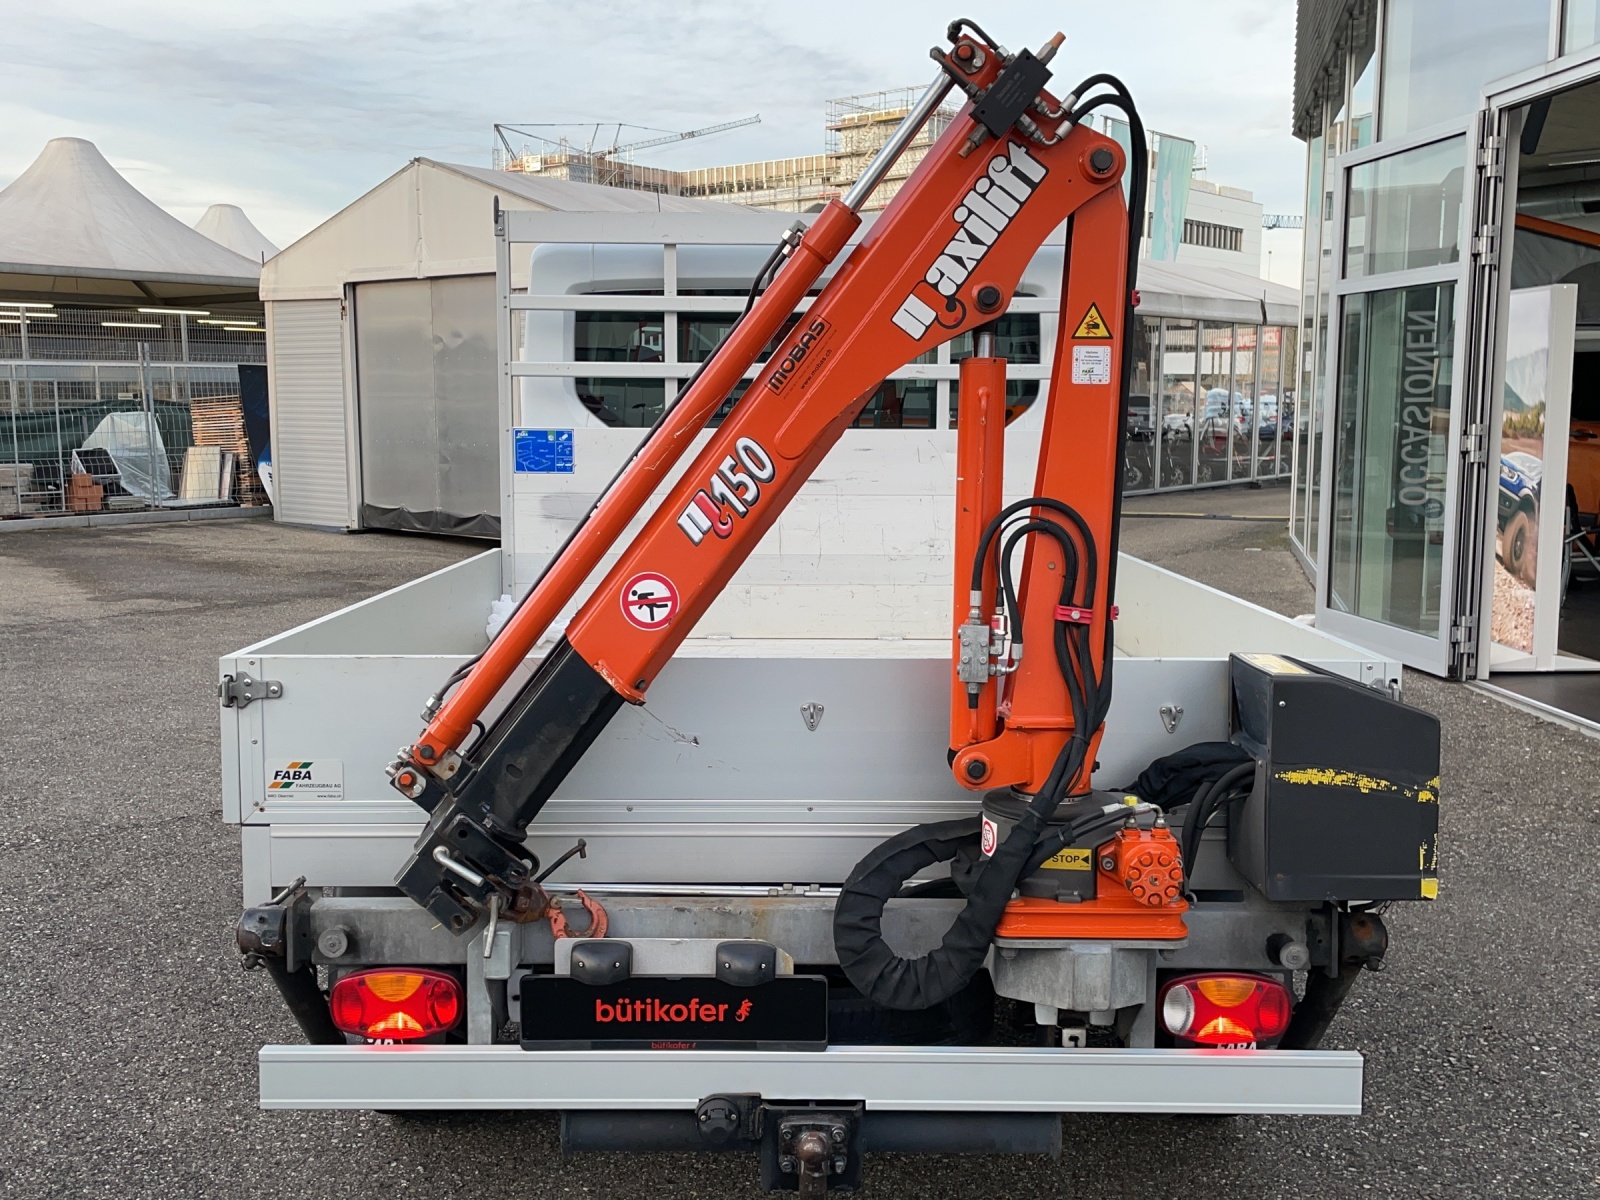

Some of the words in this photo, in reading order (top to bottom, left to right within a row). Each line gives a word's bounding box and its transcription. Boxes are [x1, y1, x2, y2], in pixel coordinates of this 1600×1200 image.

[768, 319, 826, 391] MOBAS
[800, 348, 833, 390] www.mobas.ch
[274, 770, 312, 780] FABA
[1052, 854, 1080, 863] STOP
[595, 998, 729, 1022] bütikofer
[651, 1041, 691, 1050] bütikofer
